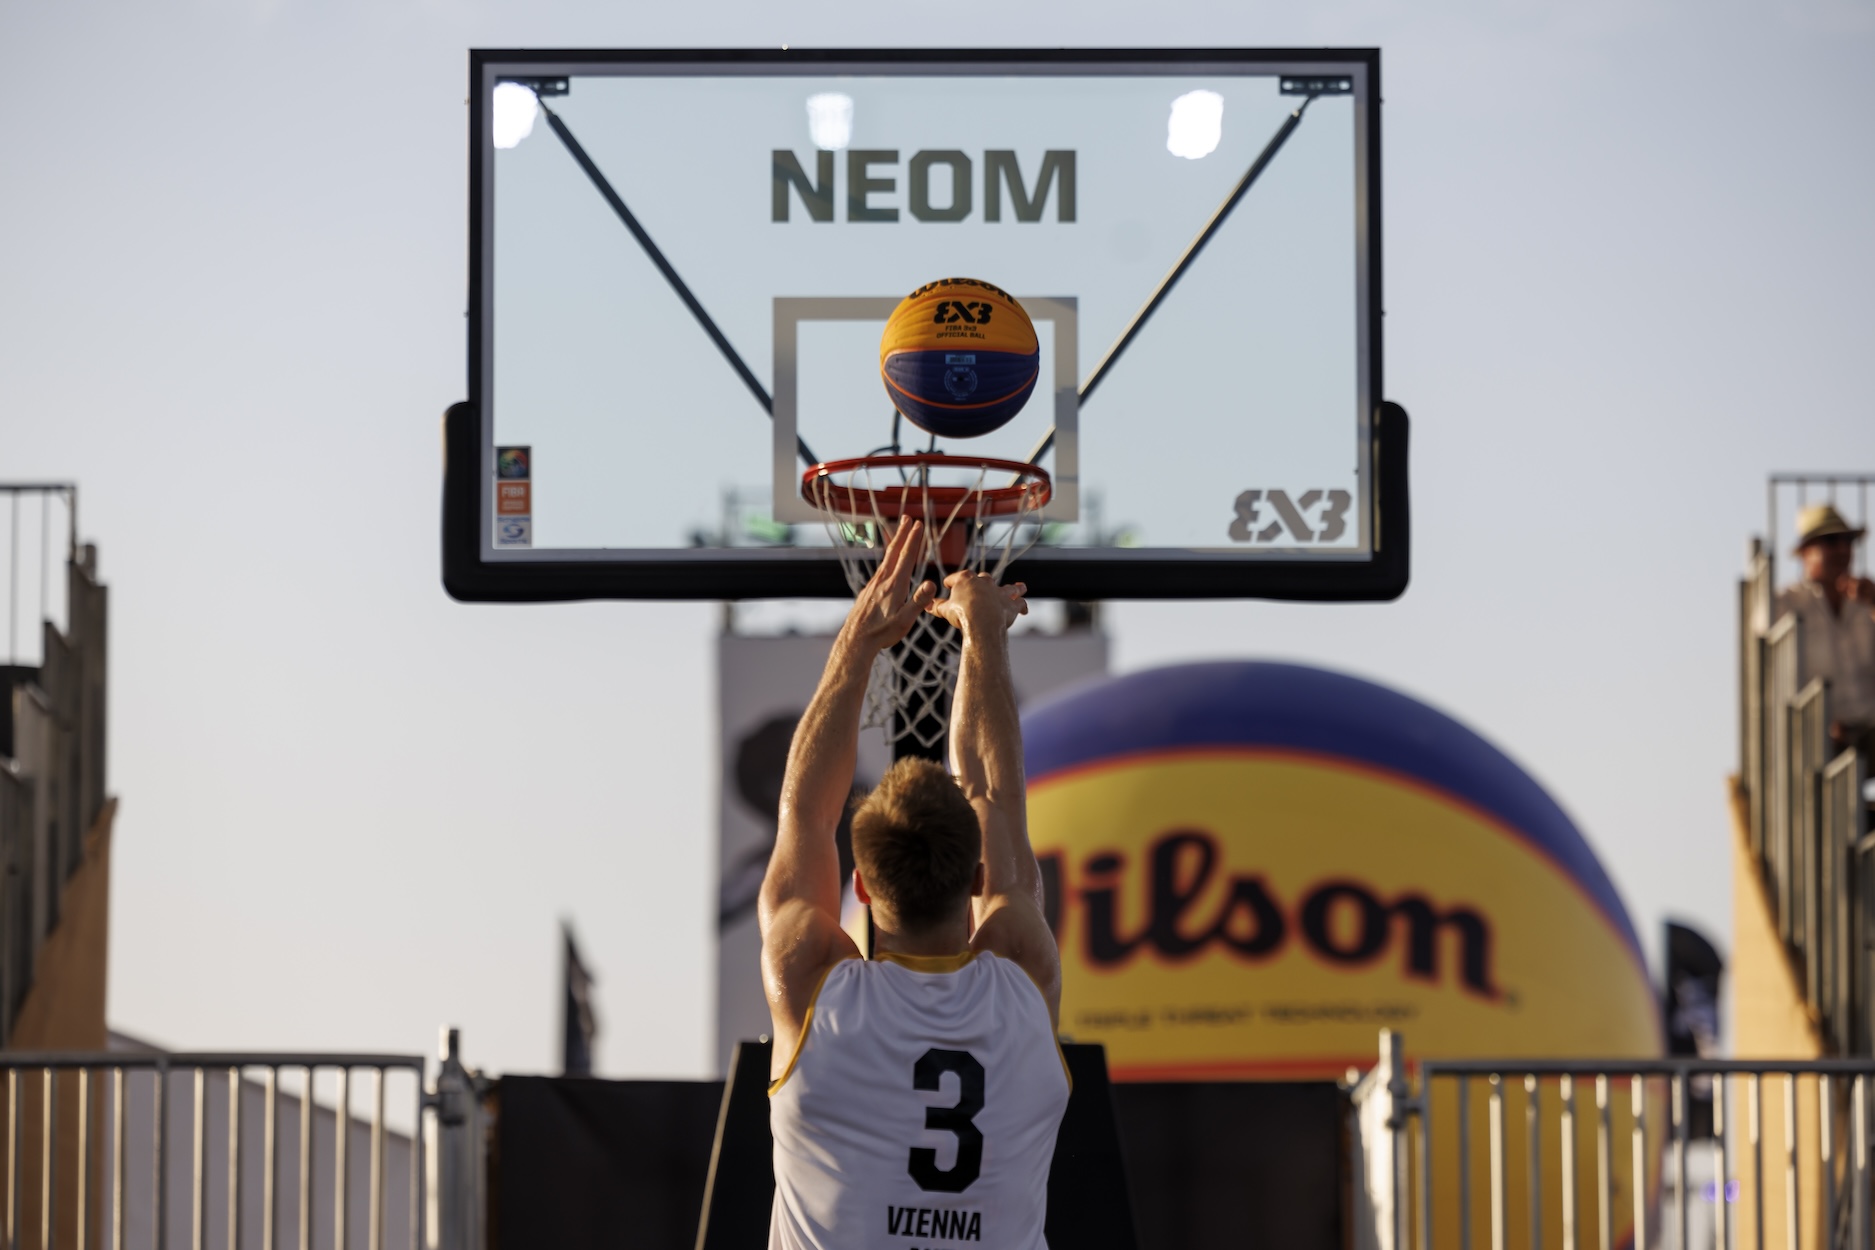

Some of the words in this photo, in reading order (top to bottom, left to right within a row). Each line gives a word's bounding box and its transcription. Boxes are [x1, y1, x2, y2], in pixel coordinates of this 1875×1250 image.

[771, 149, 1077, 223] NEOM
[936, 331, 968, 339] OFFICIAL
[908, 1048, 985, 1194] 3
[887, 1205, 982, 1242] VIENNA
